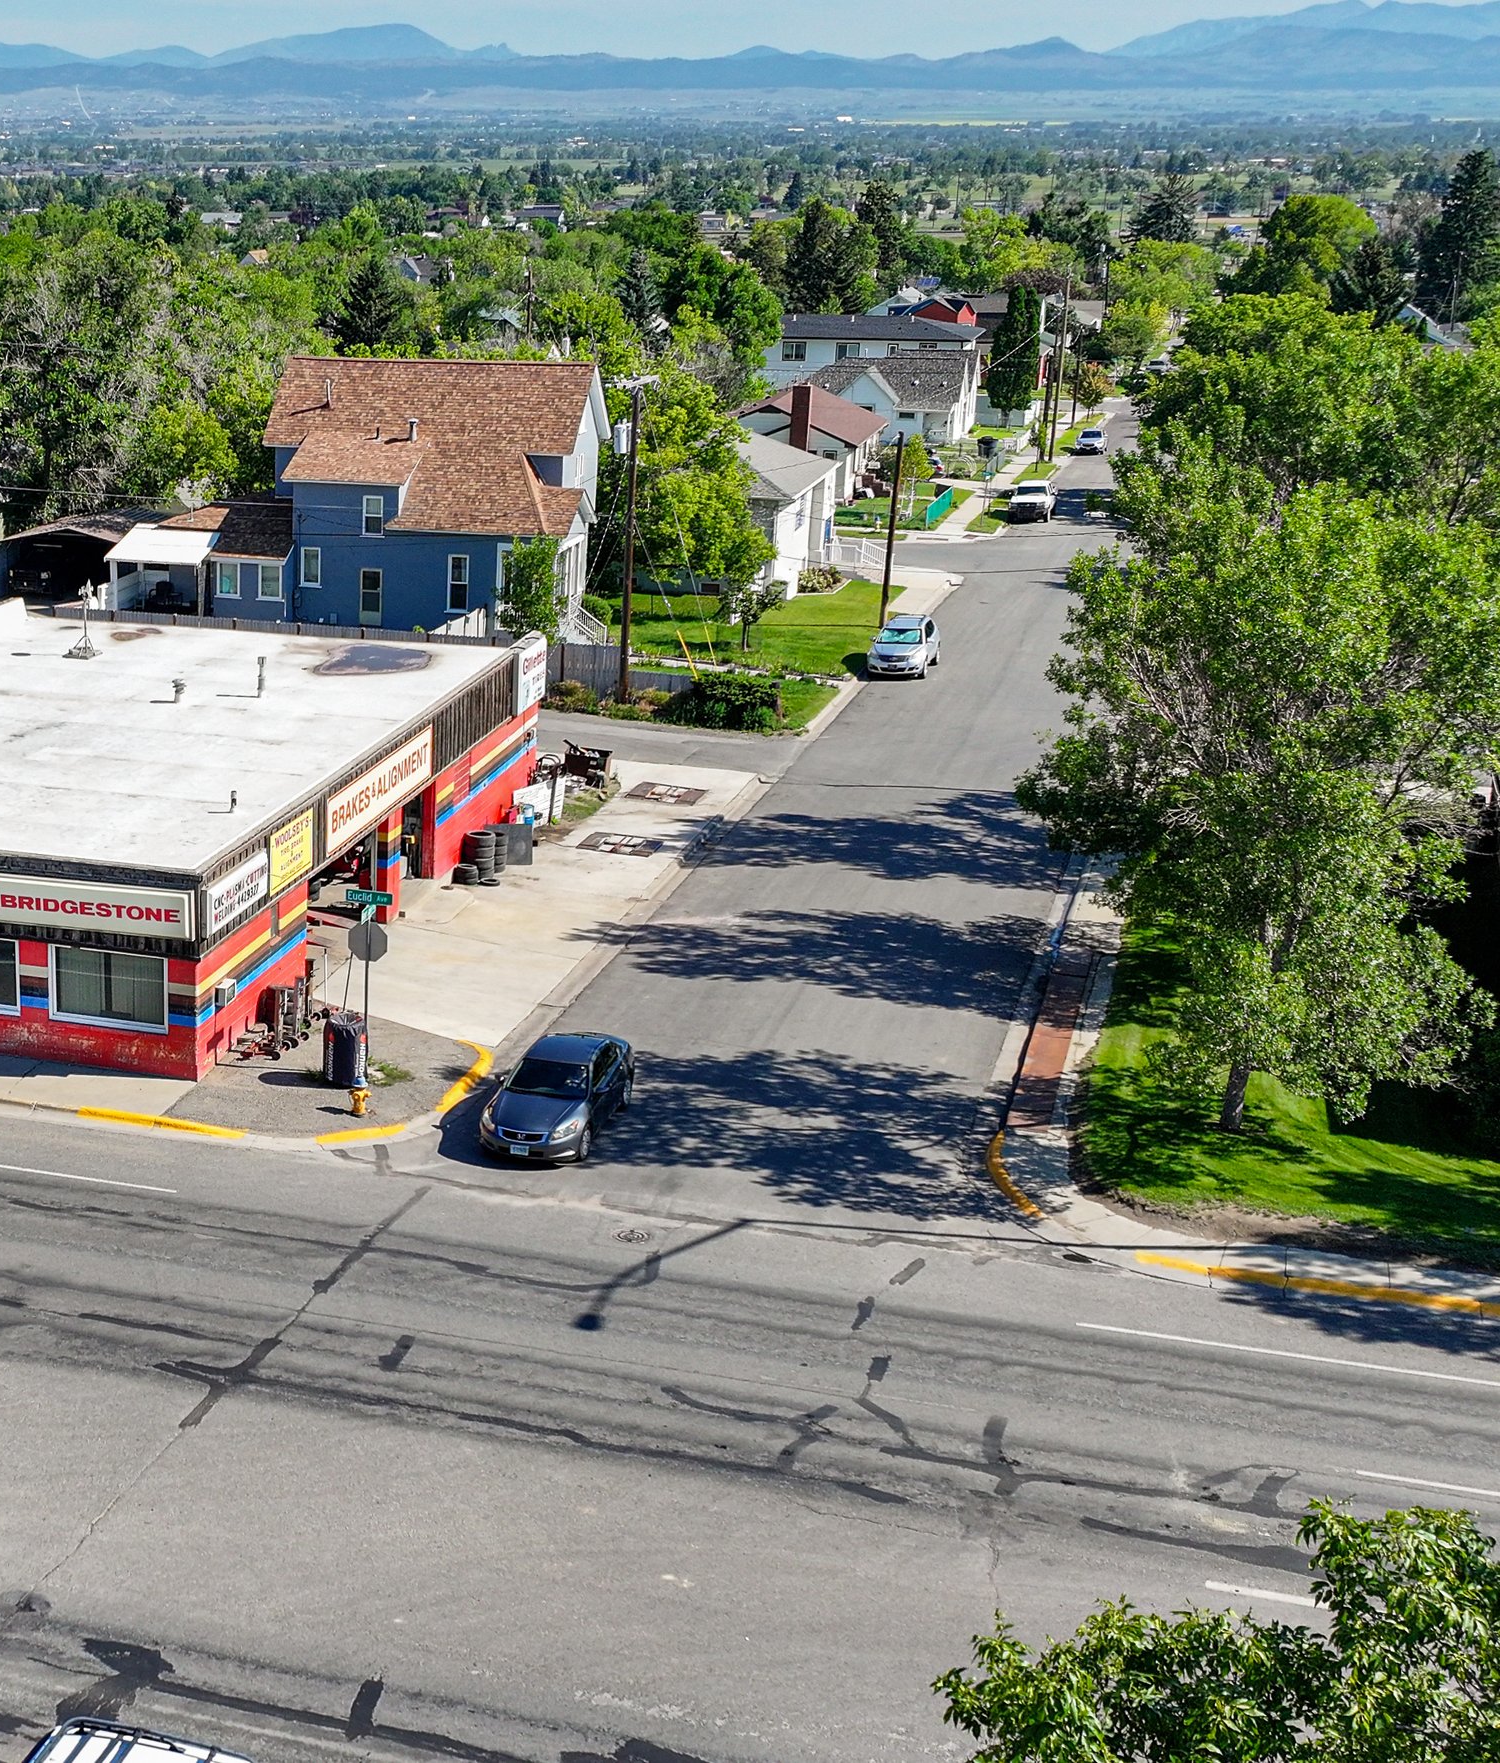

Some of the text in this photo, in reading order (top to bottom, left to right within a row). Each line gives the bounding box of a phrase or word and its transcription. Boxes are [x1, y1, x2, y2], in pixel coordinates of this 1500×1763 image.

[331, 742, 429, 834] BRAKES & ALIGNMENT
[0, 894, 181, 923] BRIDGESTONE
[347, 890, 388, 903] Euclid Ave
